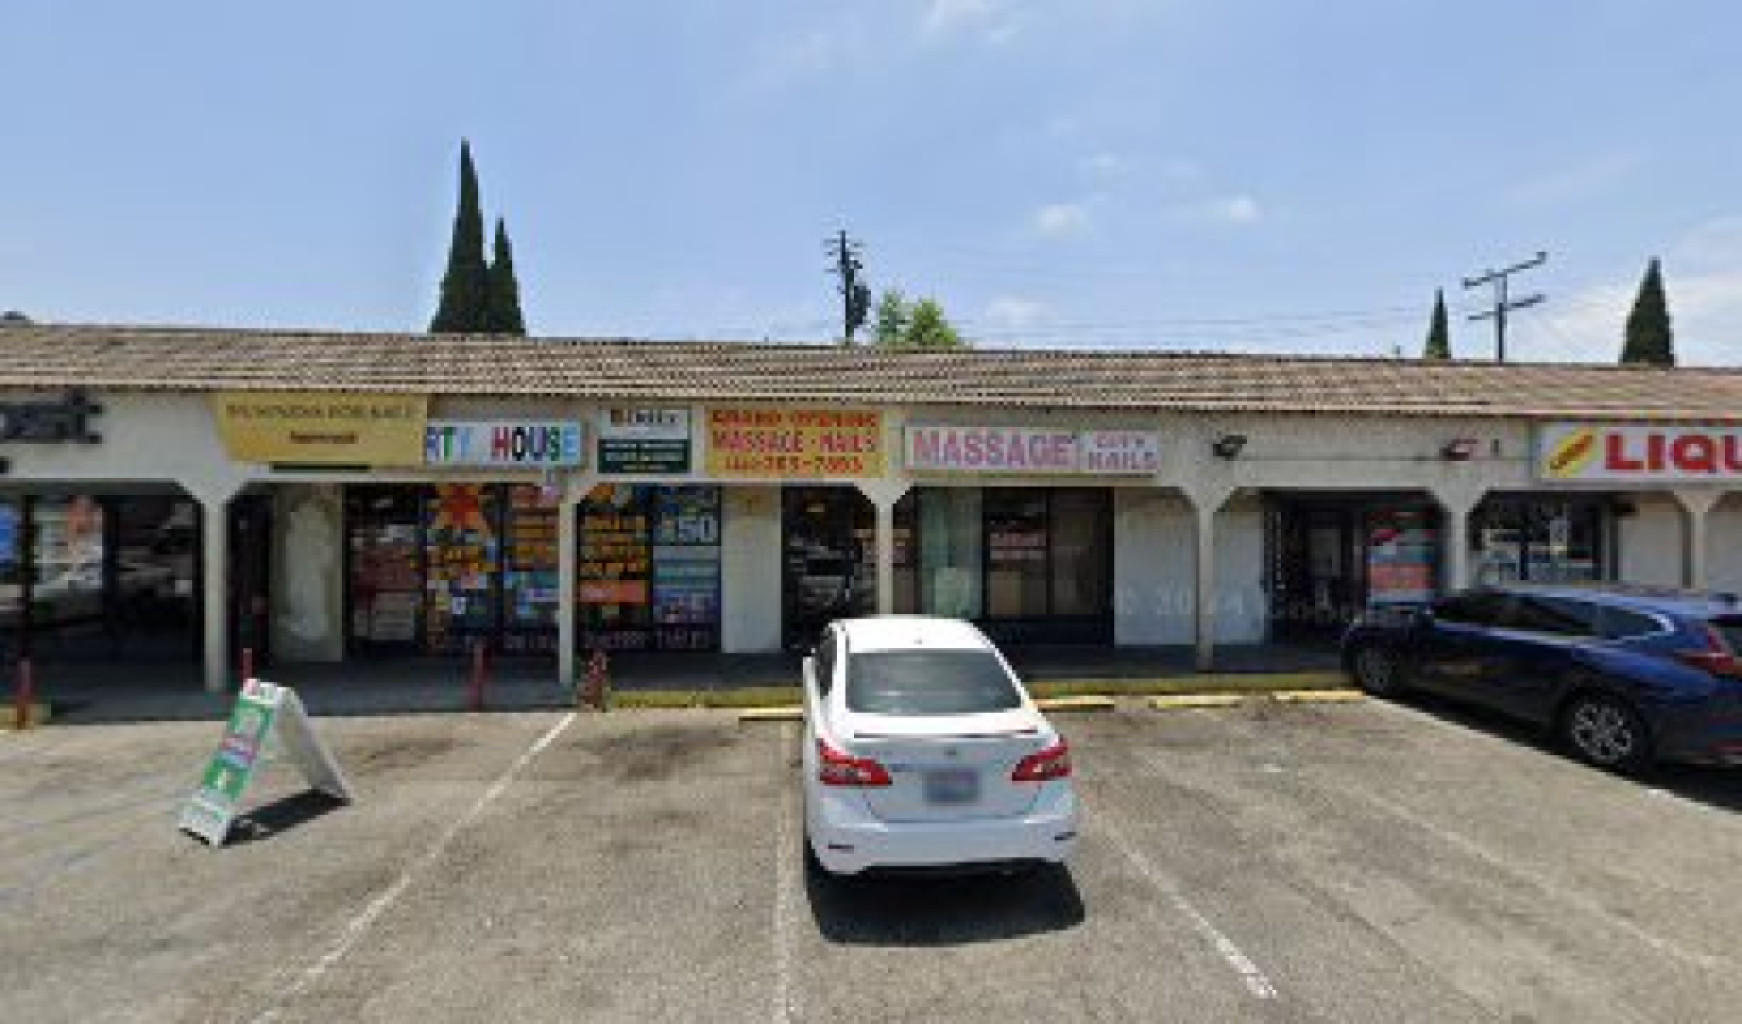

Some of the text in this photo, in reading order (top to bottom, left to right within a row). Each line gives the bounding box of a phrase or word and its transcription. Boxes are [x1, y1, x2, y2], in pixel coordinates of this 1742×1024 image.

[490, 426, 580, 462] HOUSE
[713, 430, 877, 452] MASSAGE NAILS
[912, 430, 1073, 467] MASSAGE
[1088, 451, 1159, 470] NAILS
